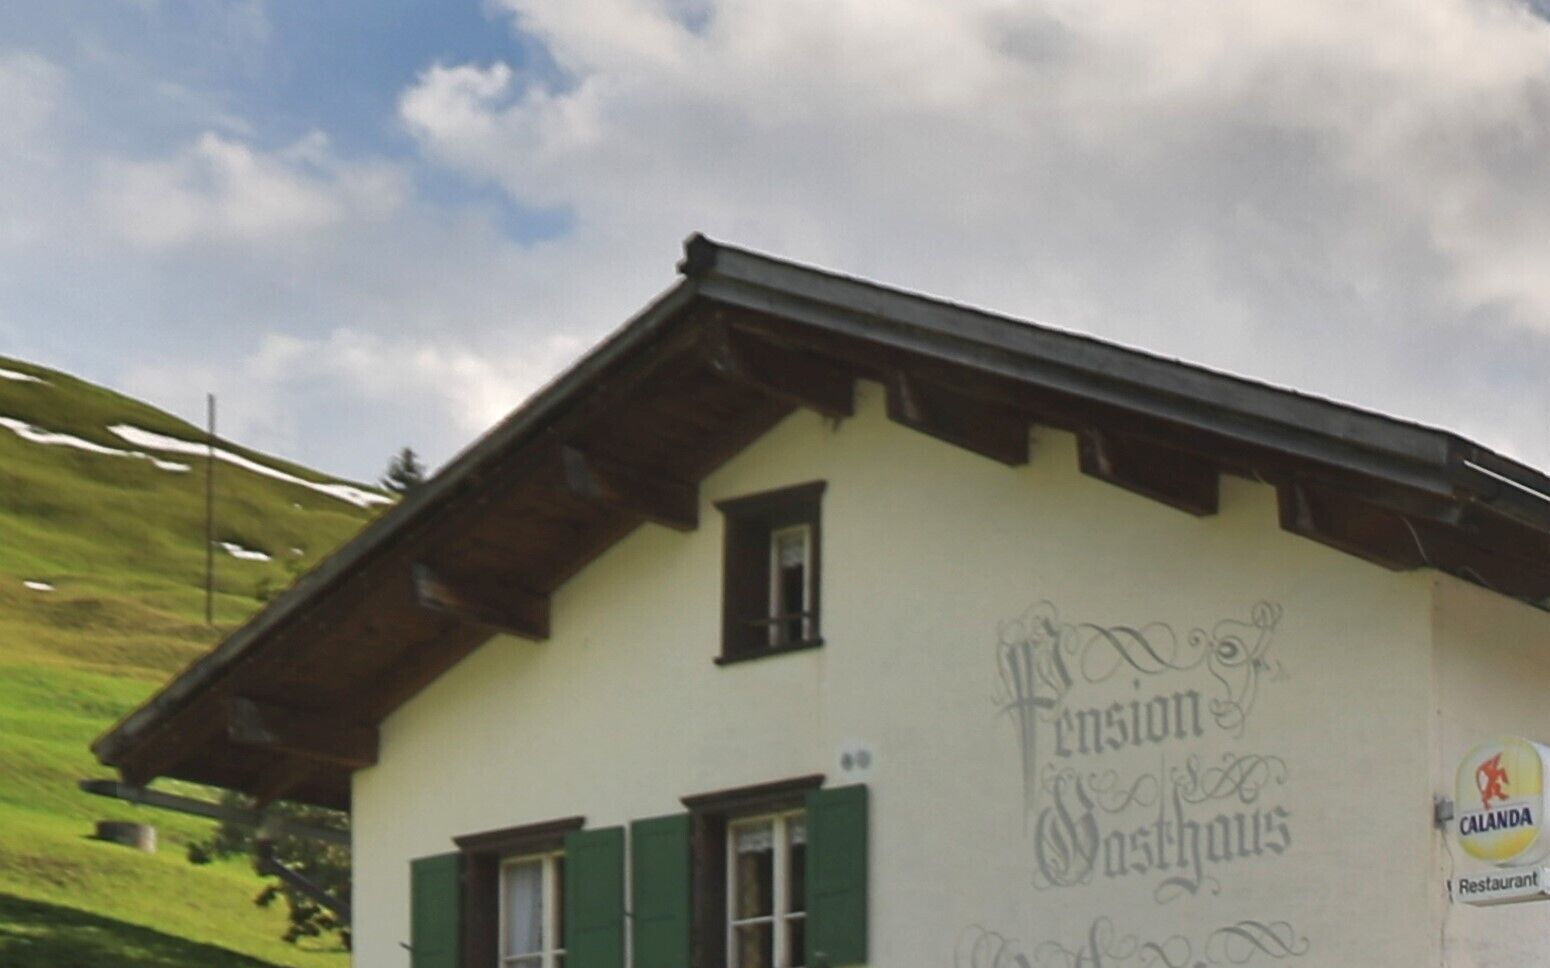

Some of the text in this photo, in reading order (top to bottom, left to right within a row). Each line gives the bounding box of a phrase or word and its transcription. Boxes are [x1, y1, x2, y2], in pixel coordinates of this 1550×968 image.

[995, 602, 1205, 835] Pension
[1032, 762, 1293, 895] Gasthaus
[1459, 807, 1533, 836] CALANDA
[1458, 871, 1538, 894] Restaurant
